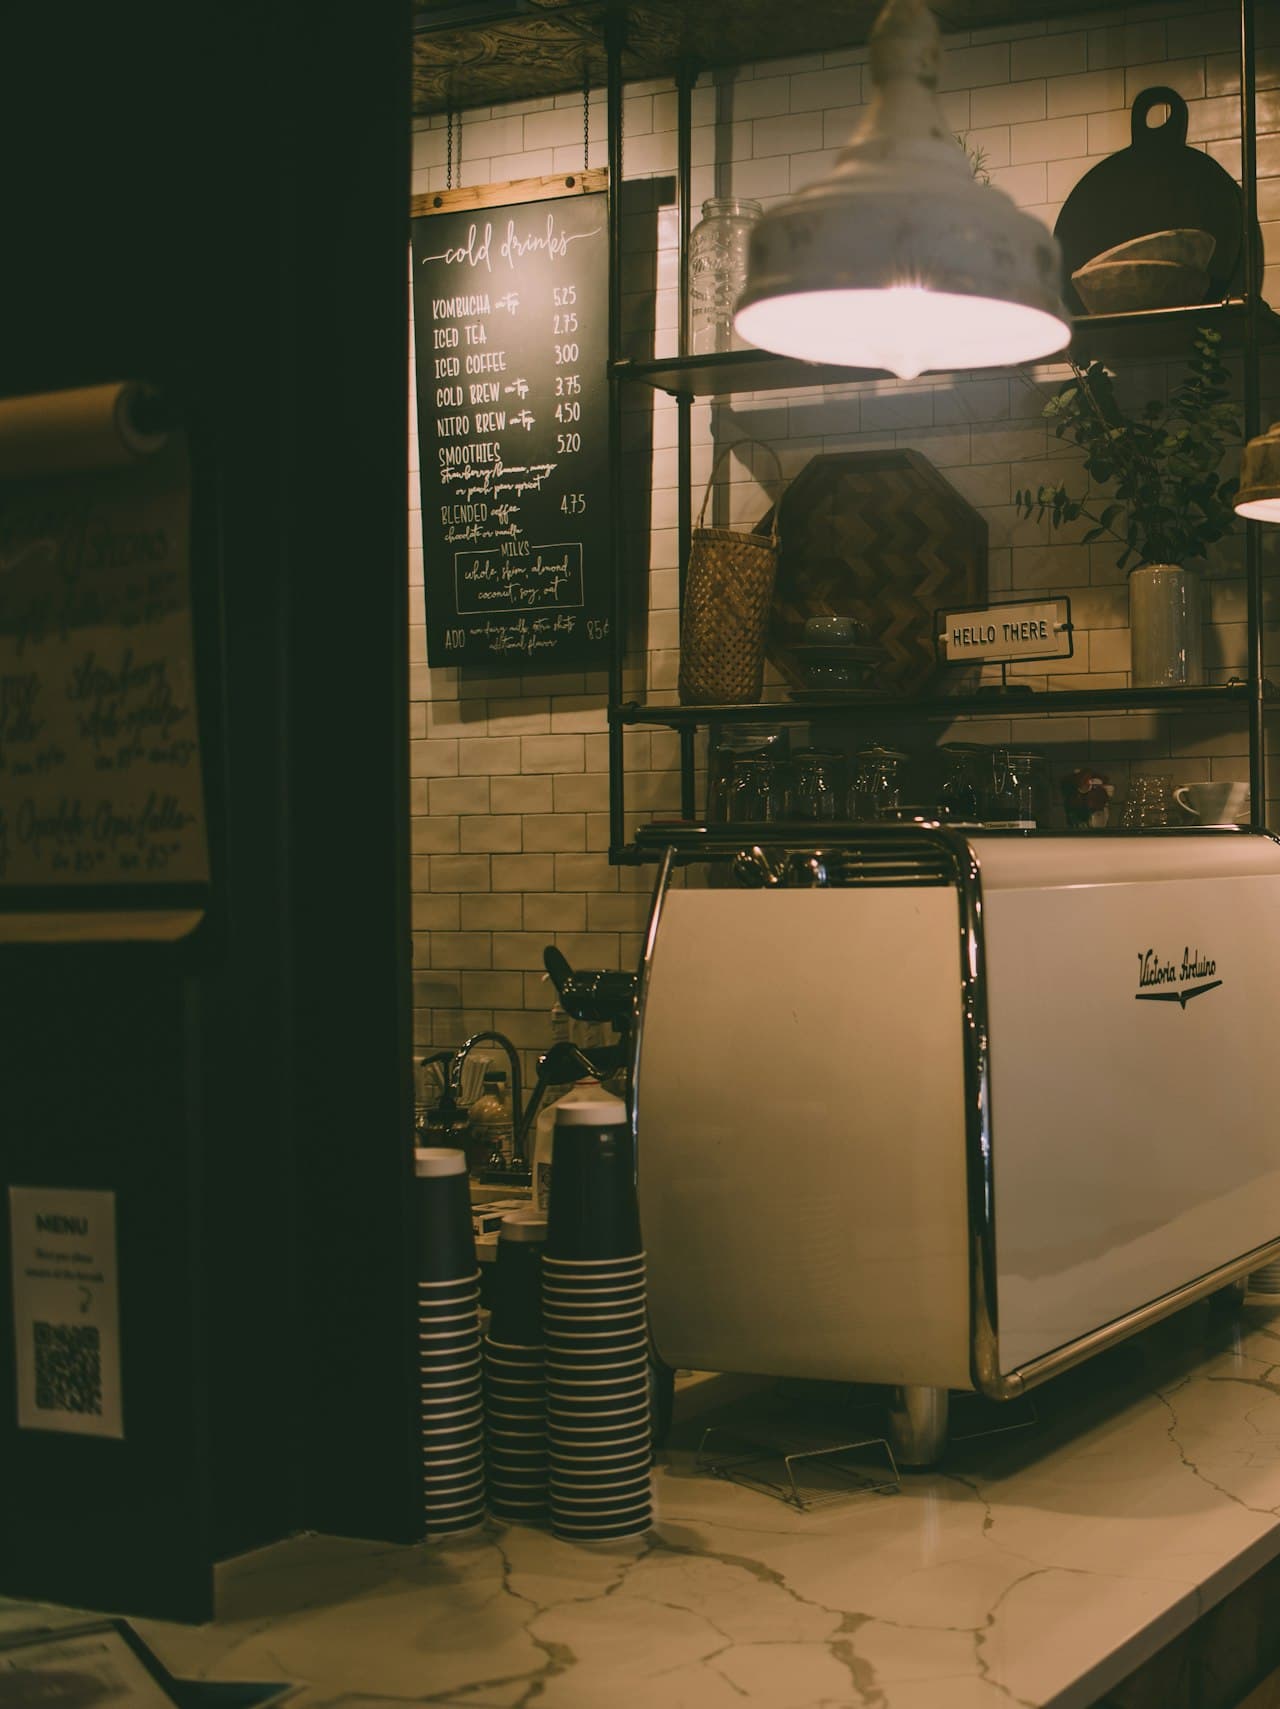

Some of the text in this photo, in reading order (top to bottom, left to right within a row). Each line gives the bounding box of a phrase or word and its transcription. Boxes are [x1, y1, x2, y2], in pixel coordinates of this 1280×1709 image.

[423, 214, 602, 272] cold drinks
[432, 293, 491, 321] KOMBUCHA
[433, 313, 579, 349] ICED TEA 2.75
[435, 343, 579, 379] ICED COFFEE 3.00
[436, 386, 464, 408] COLD
[470, 382, 501, 405] BREW
[555, 375, 582, 398] 3.75
[437, 415, 470, 438] NITRO
[475, 411, 506, 434] BREW
[554, 401, 581, 423] 4.50
[438, 442, 502, 468] SMOOTHIES
[440, 503, 488, 525] BLENDED
[560, 494, 586, 514] 4.75
[500, 540, 530, 557] MILKS
[953, 619, 1048, 647] HELLO THERE
[1137, 946, 1217, 988] Victoria Arduino
